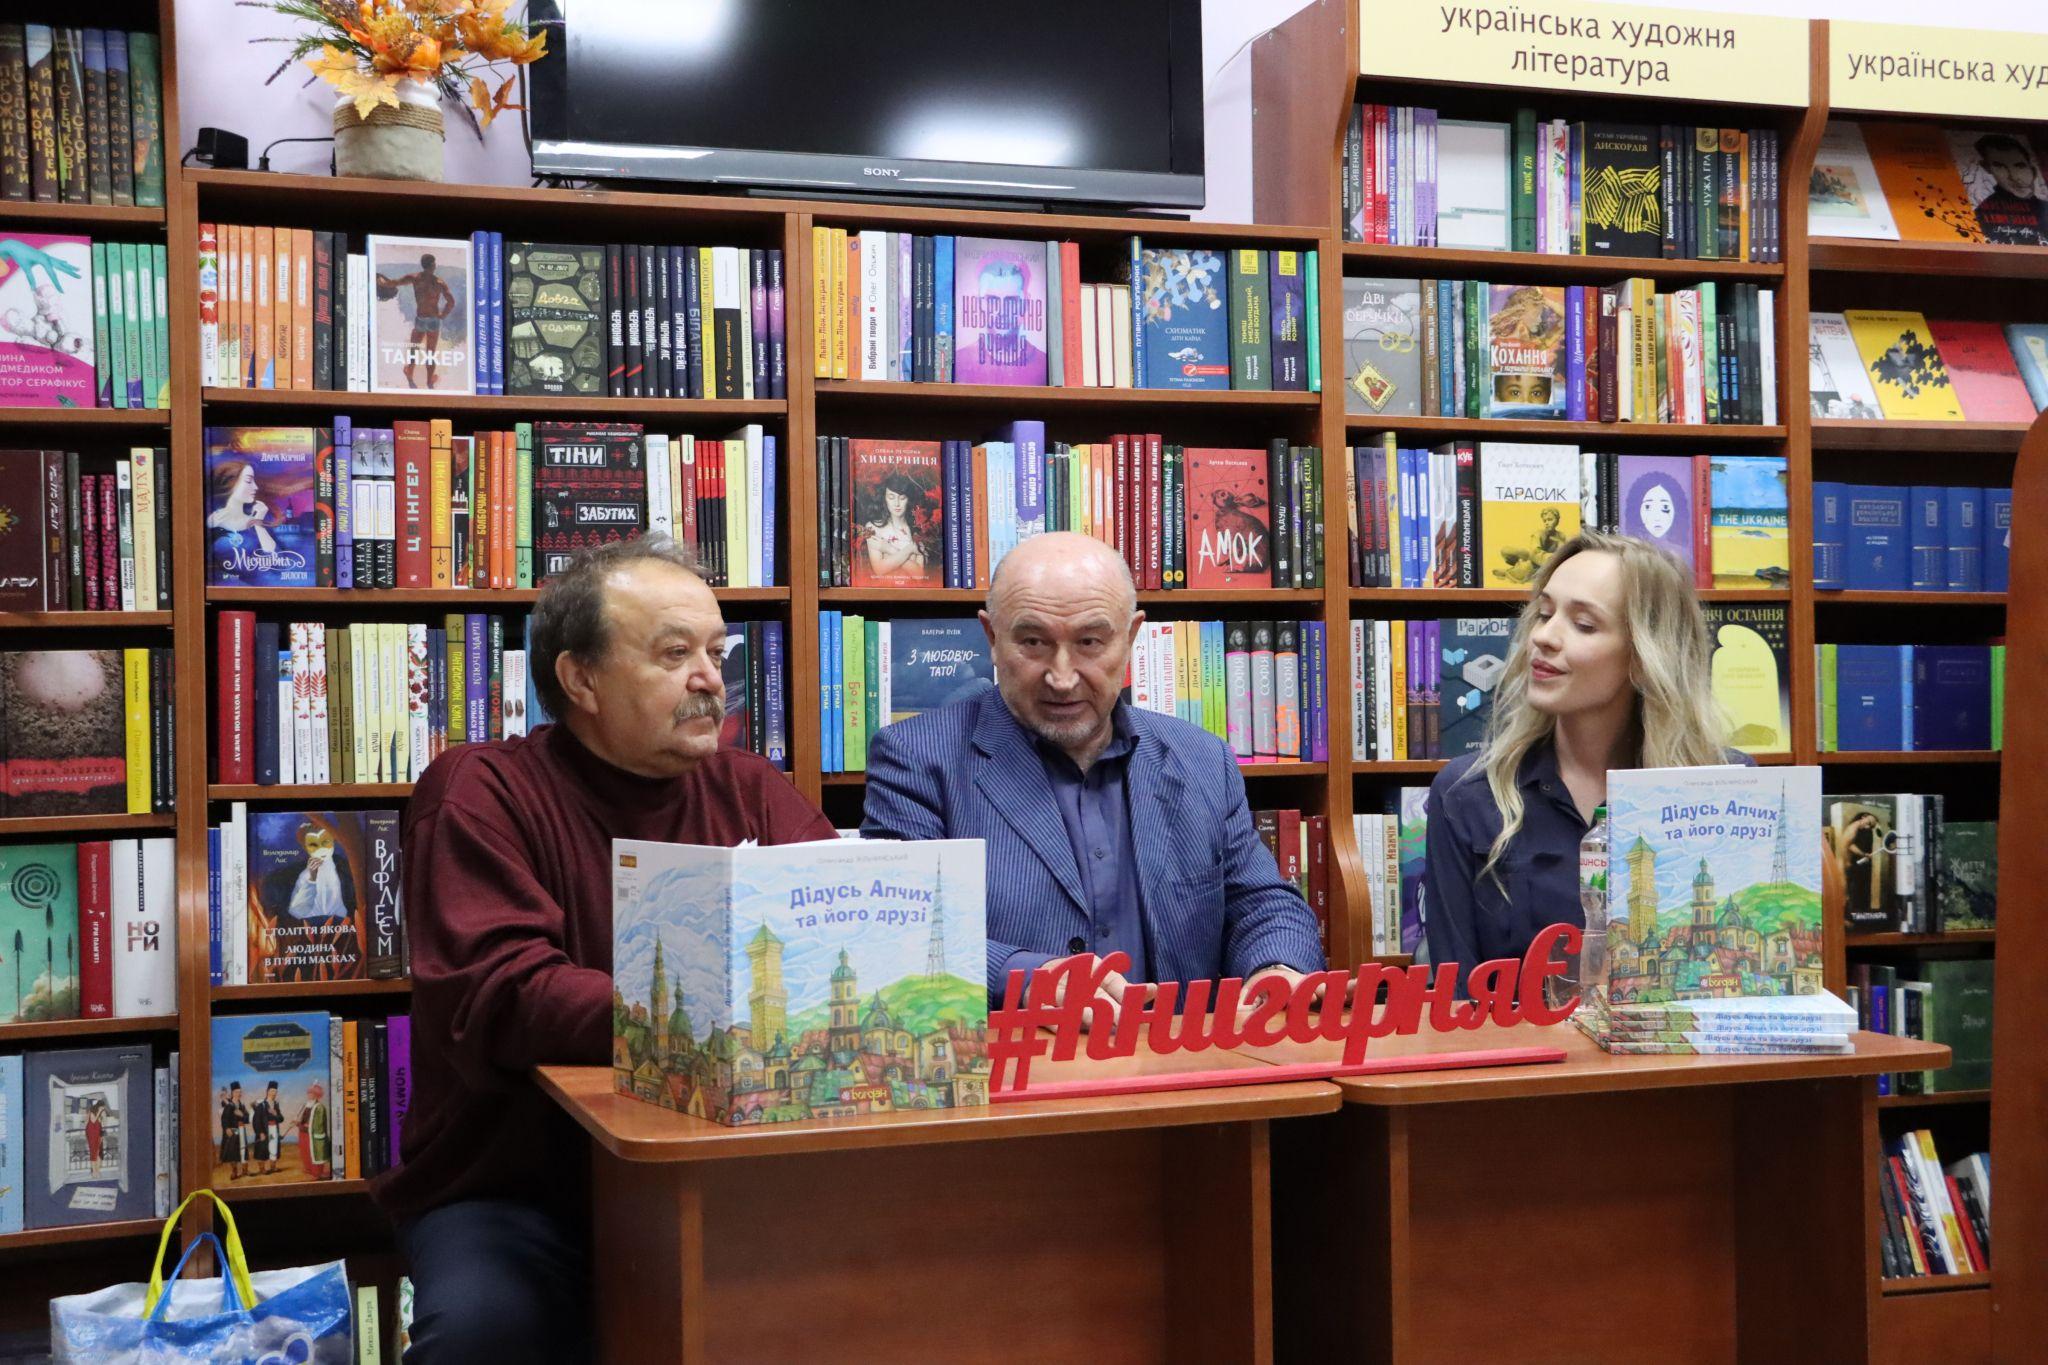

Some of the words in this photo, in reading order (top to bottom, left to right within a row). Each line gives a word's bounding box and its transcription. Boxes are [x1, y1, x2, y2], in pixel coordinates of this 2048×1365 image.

[1440, 5, 1600, 39] українська
[1612, 20, 1736, 49] художня
[1509, 45, 1671, 85] література
[1847, 51, 1996, 82] українська
[1594, 142, 1648, 152] ДИСКОРДІЯ
[863, 166, 901, 179] SONY
[1703, 154, 1713, 172] ГРА
[1703, 174, 1713, 206] ЧУЖА
[611, 309, 624, 347] ЧЕРВОНИЙ
[628, 309, 641, 347] ЧЕРВОНИЙ
[660, 320, 670, 348] ЧОРНИЙ
[675, 312, 686, 349] БАГРЯНИЙ
[688, 308, 700, 341] БІЛА
[381, 346, 466, 367] ТАНЖЕР
[676, 351, 686, 370] РЕЙД
[869, 339, 877, 370] Вибрані
[1490, 344, 1548, 367] КОХАННЯ
[26, 379, 88, 389] СЕРАФІКУС
[548, 446, 604, 466] ТІНИ
[859, 454, 939, 466] ХИМЕРНИЦЯ
[1494, 486, 1567, 501] ТАРАСИК
[578, 506, 636, 522] ЗАБУТИХ
[1719, 514, 1738, 525] THE
[1740, 514, 1787, 526] UKRAINE
[1198, 528, 1263, 574] АМОК
[356, 542, 365, 584] ЛІНА
[365, 542, 373, 585] КОСТЕНКО
[377, 542, 386, 584] ЛІНА
[386, 542, 394, 585] КОСТЕНКО
[1727, 608, 1785, 622] ОСТАННЯ
[907, 648, 917, 666] З
[1136, 644, 1148, 689] Гудзик-2
[929, 664, 957, 678] ТАТО!
[1660, 802, 1719, 825] Дідусь
[1725, 800, 1777, 821] Апчих
[1665, 829, 1682, 841] та
[1688, 823, 1724, 838] його
[1729, 825, 1772, 840] друзі
[789, 878, 862, 910] Дідусь
[869, 879, 933, 904] Апчих
[795, 914, 817, 929] та
[824, 905, 870, 926] його
[875, 907, 926, 926] друзі
[264, 926, 318, 937] СТОЛІТТЯ
[319, 924, 357, 935] ЯКОВА
[285, 942, 335, 954] ЛЮДИНА
[264, 958, 271, 967] В
[309, 953, 356, 964] МАСКАХ
